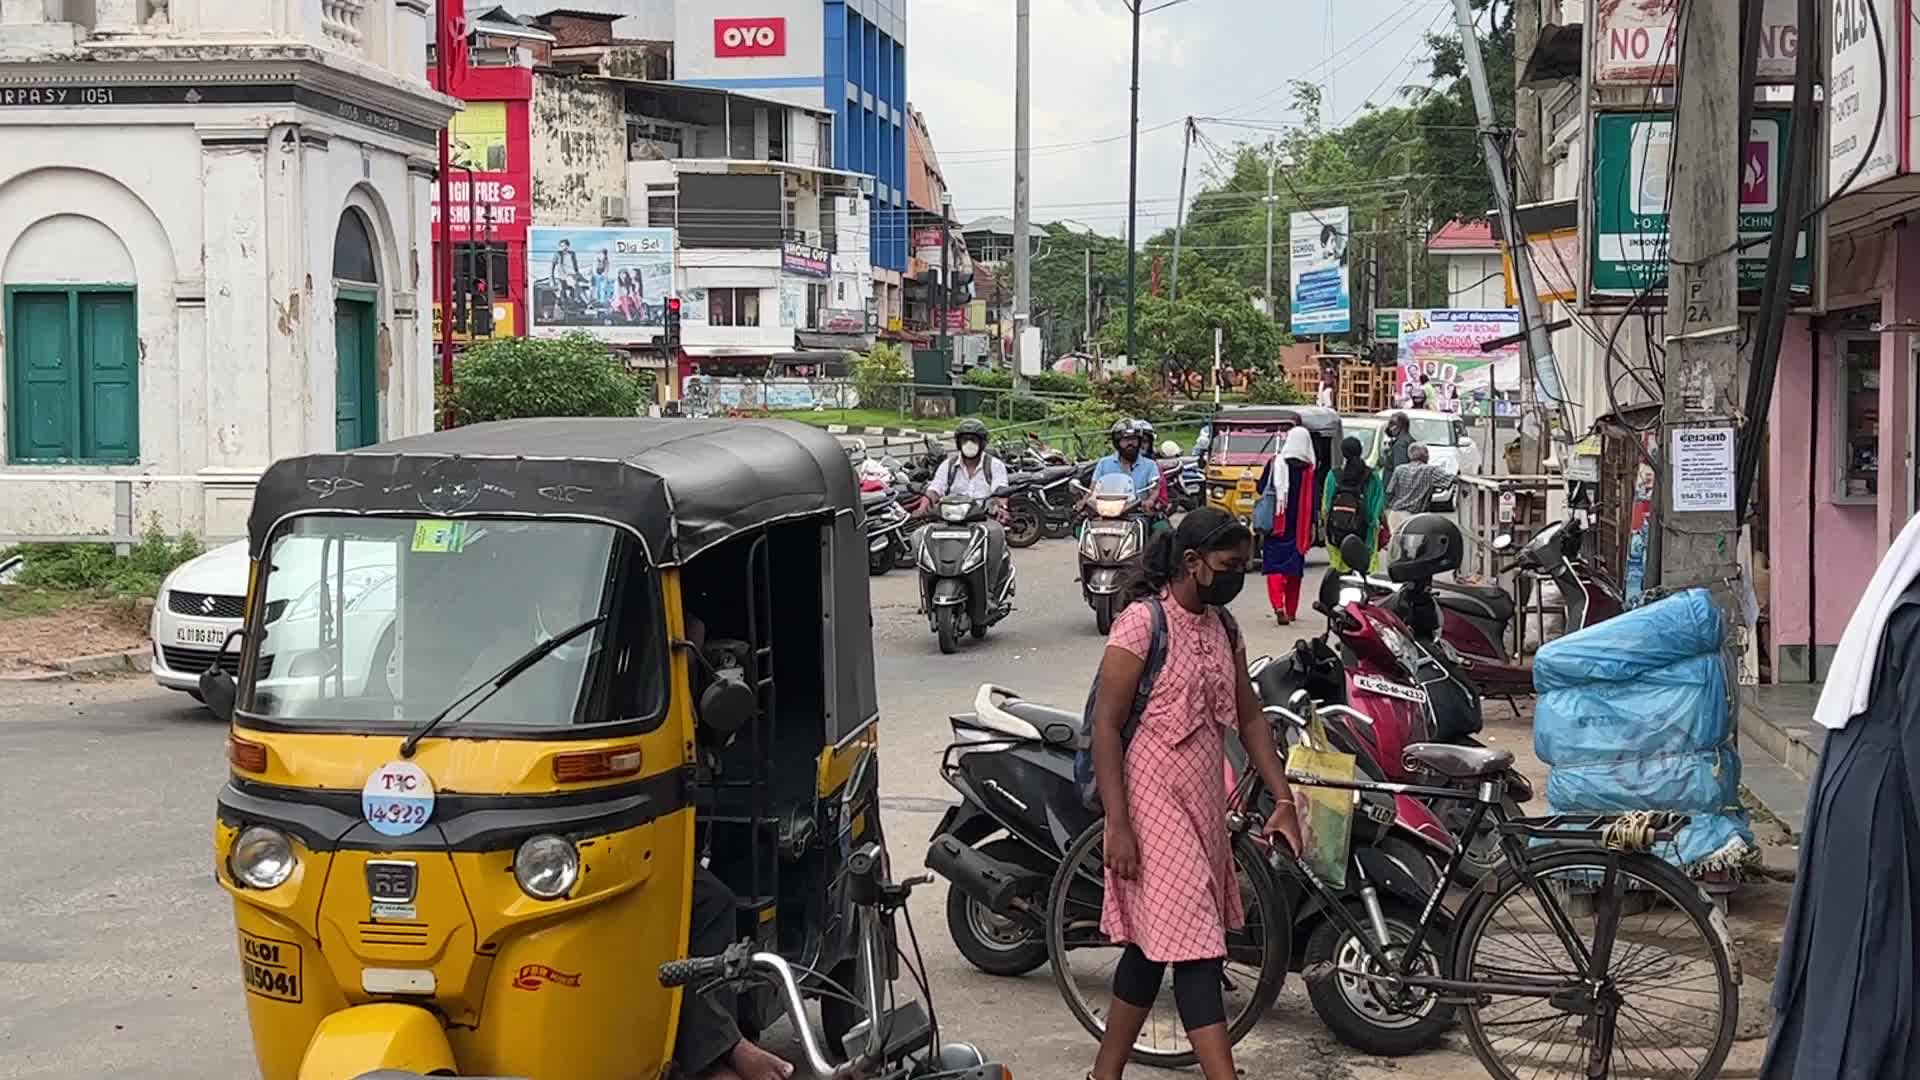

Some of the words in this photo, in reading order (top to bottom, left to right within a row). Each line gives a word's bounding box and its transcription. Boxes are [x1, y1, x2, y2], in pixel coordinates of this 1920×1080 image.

[723, 26, 775, 47] OYO
[1610, 28, 1650, 60] NO
[0, 88, 67, 105] RPASY
[81, 88, 113, 104] 1051
[475, 181, 500, 202] FREE
[812, 248, 829, 262] OFF
